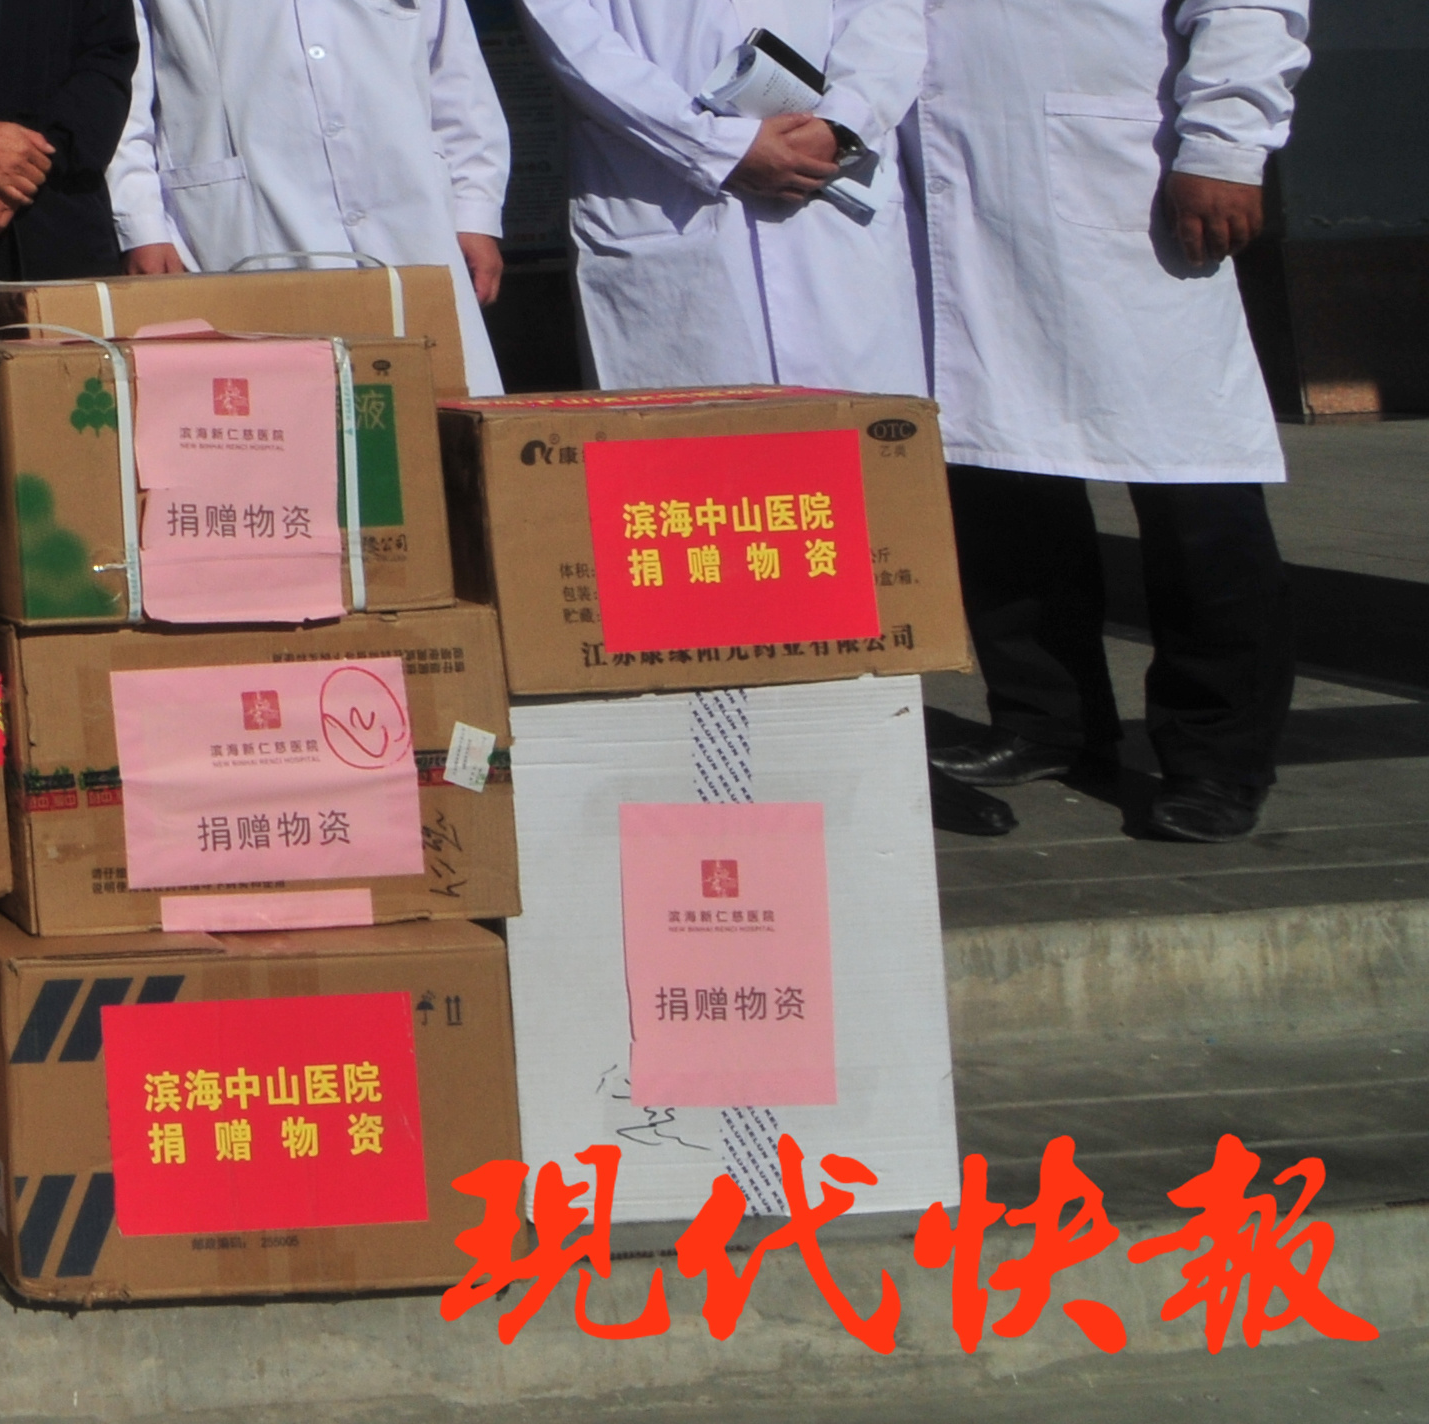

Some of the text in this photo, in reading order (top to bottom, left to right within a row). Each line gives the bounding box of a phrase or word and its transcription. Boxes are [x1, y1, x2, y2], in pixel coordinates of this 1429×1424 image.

[872, 421, 913, 440] OTC
[167, 502, 312, 539] 捐赠物资
[622, 492, 834, 540] 滨海中山医院
[627, 539, 838, 587] 捐赠物资
[198, 809, 353, 853] 捐赠物资
[655, 986, 806, 1022] 捐赠物资
[144, 1061, 382, 1114] 滨海中山医院
[148, 1113, 384, 1165] 捐赠物资
